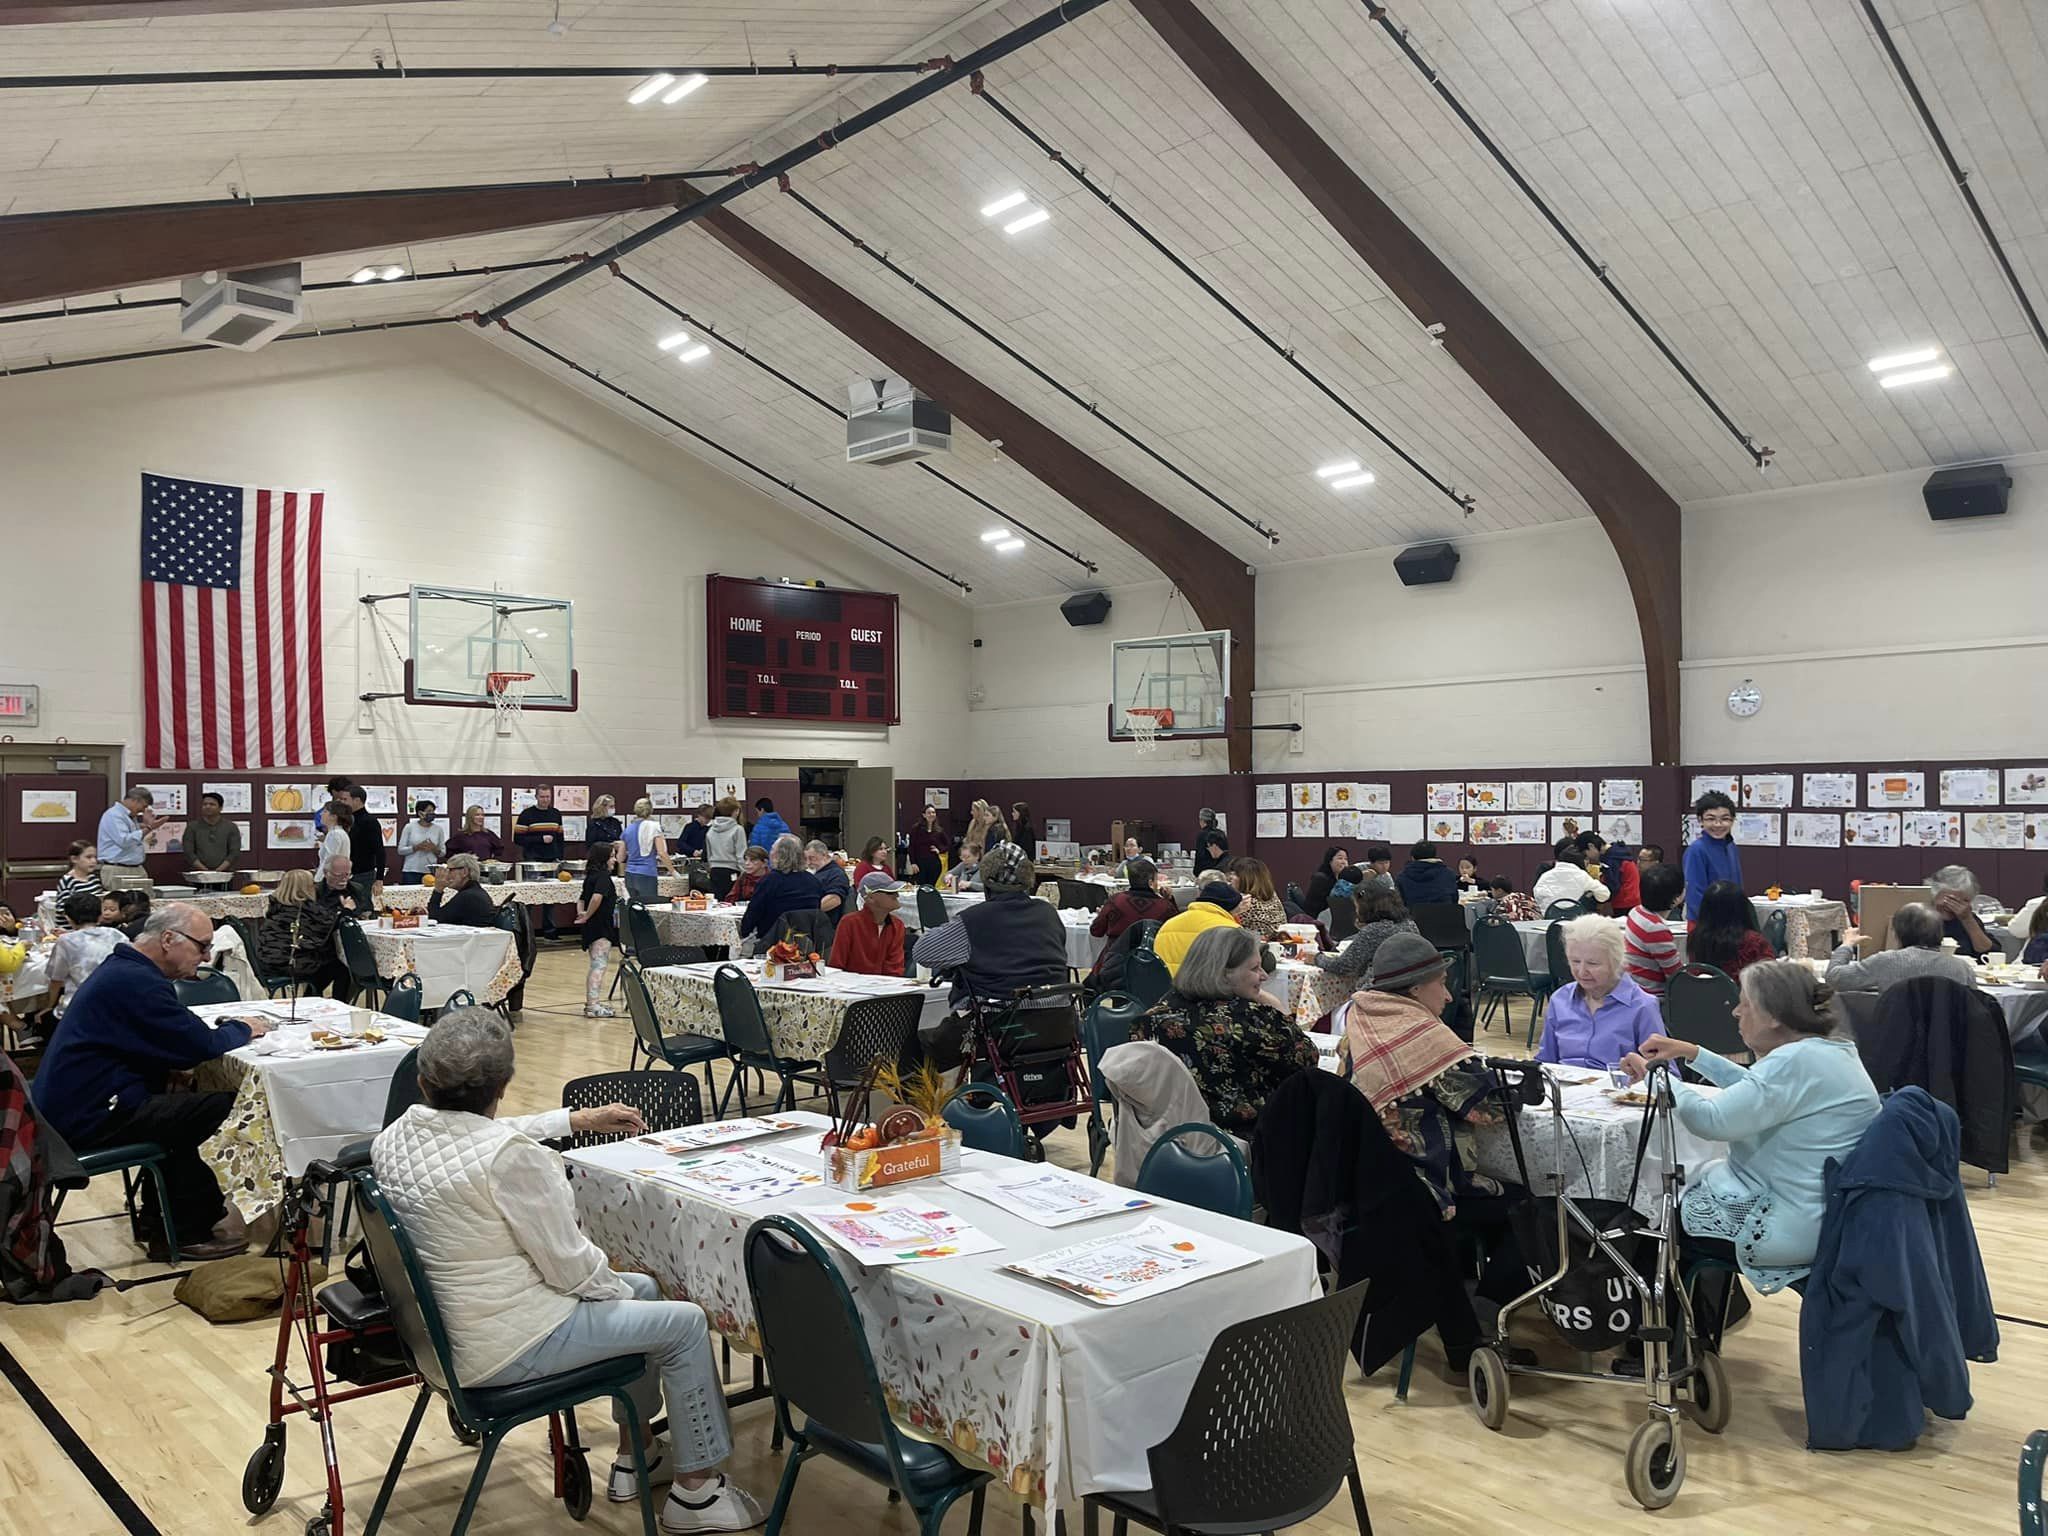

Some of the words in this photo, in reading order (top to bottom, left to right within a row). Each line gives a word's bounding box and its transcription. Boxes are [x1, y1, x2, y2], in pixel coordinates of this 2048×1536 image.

[729, 617, 763, 633] HOME
[795, 630, 822, 641] PERIOD
[850, 628, 883, 643] GUEST
[756, 674, 778, 685] T.O.L.
[883, 1154, 930, 1176] Grateful
